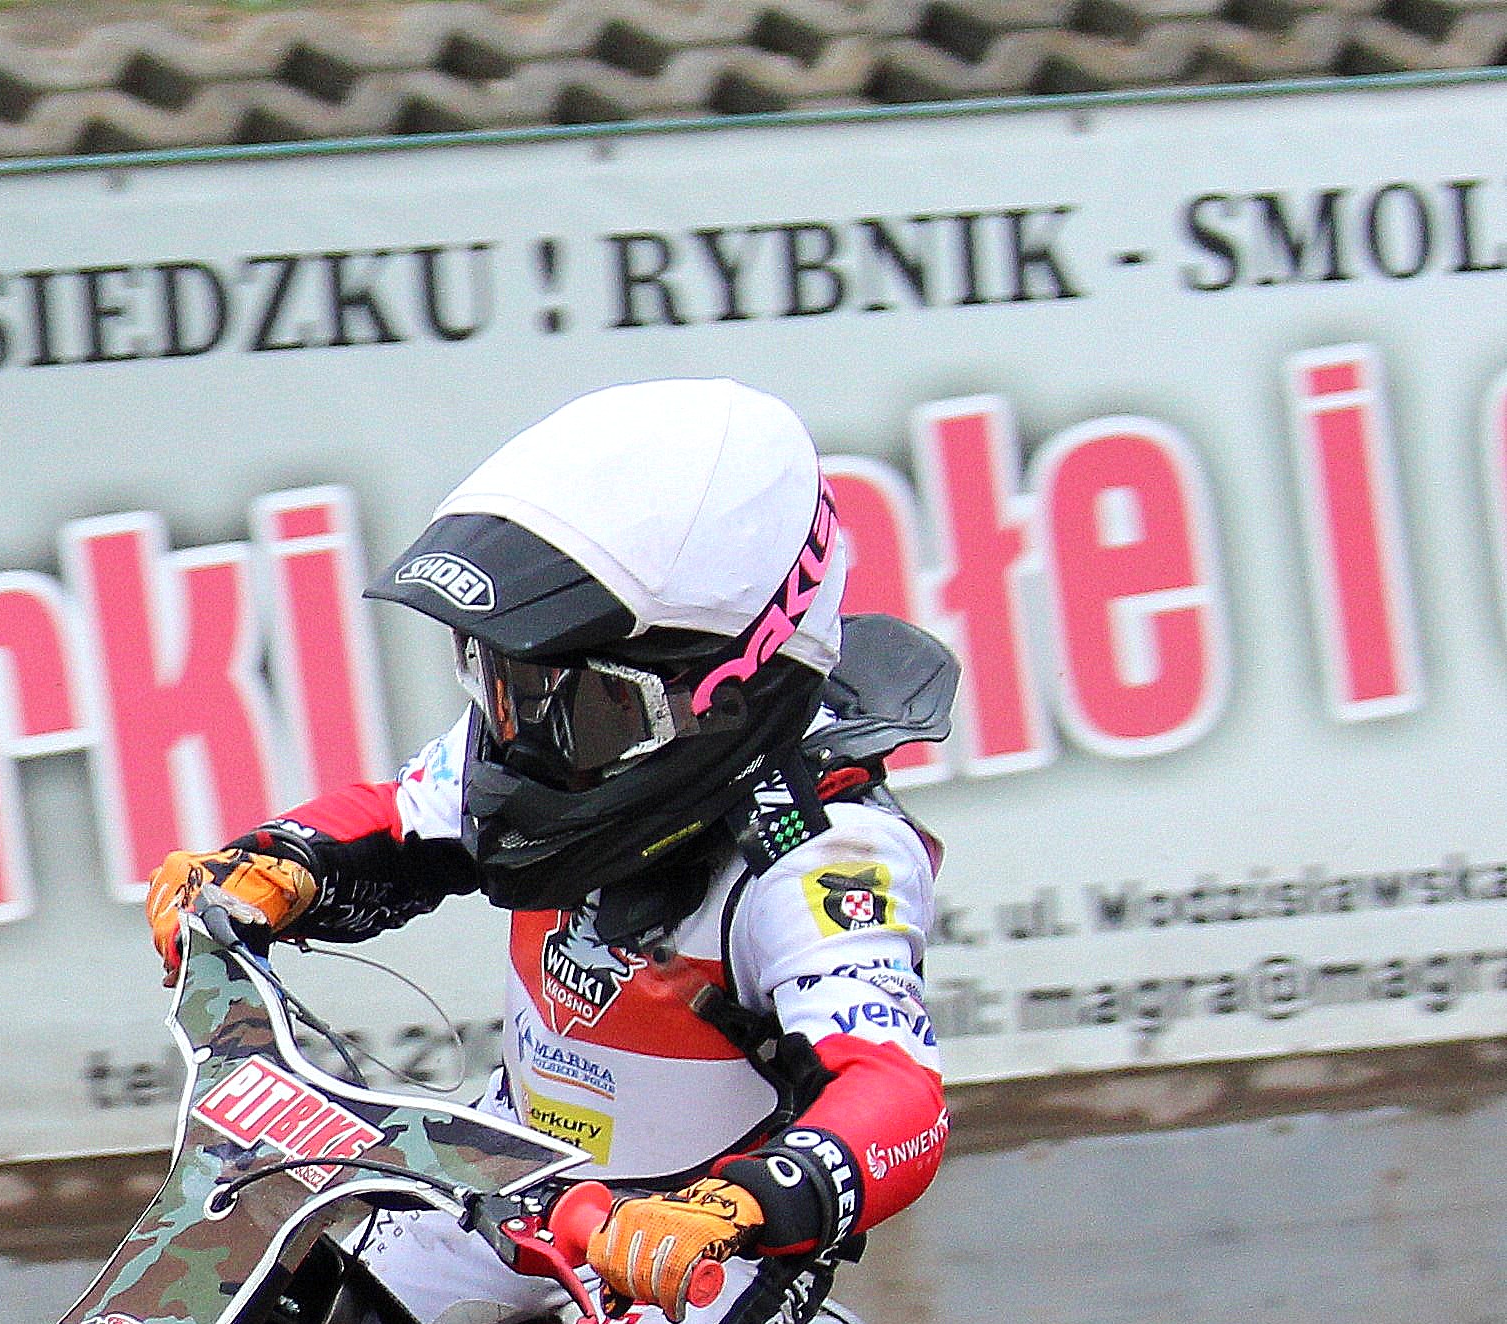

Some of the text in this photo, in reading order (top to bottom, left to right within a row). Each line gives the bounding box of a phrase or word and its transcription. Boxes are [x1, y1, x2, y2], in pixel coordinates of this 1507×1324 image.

[601, 205, 1084, 331] RYBNIK
[406, 554, 484, 606] SHOEI
[545, 977, 594, 1019] KROSNO
[547, 944, 606, 1005] WILKI
[533, 1041, 617, 1085] MARMA
[205, 1060, 297, 1133] PIT
